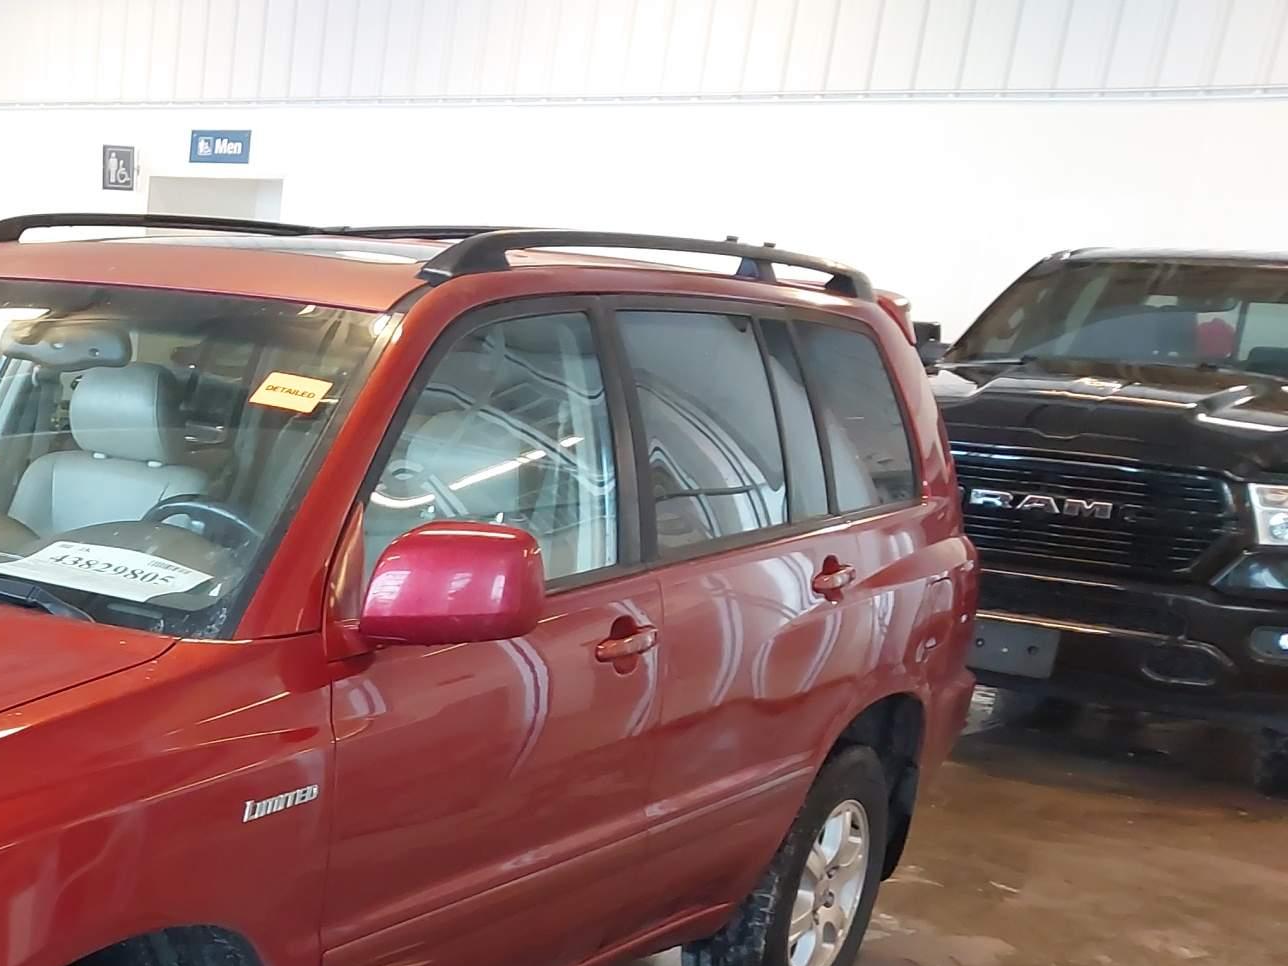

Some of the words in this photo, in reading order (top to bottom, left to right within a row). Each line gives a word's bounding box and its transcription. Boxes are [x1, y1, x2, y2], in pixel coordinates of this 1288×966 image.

[214, 137, 243, 155] Men
[265, 384, 316, 399] DETAILED
[969, 488, 1113, 520] RAM
[49, 554, 176, 585] 43829805
[242, 784, 319, 823] LIMITED
